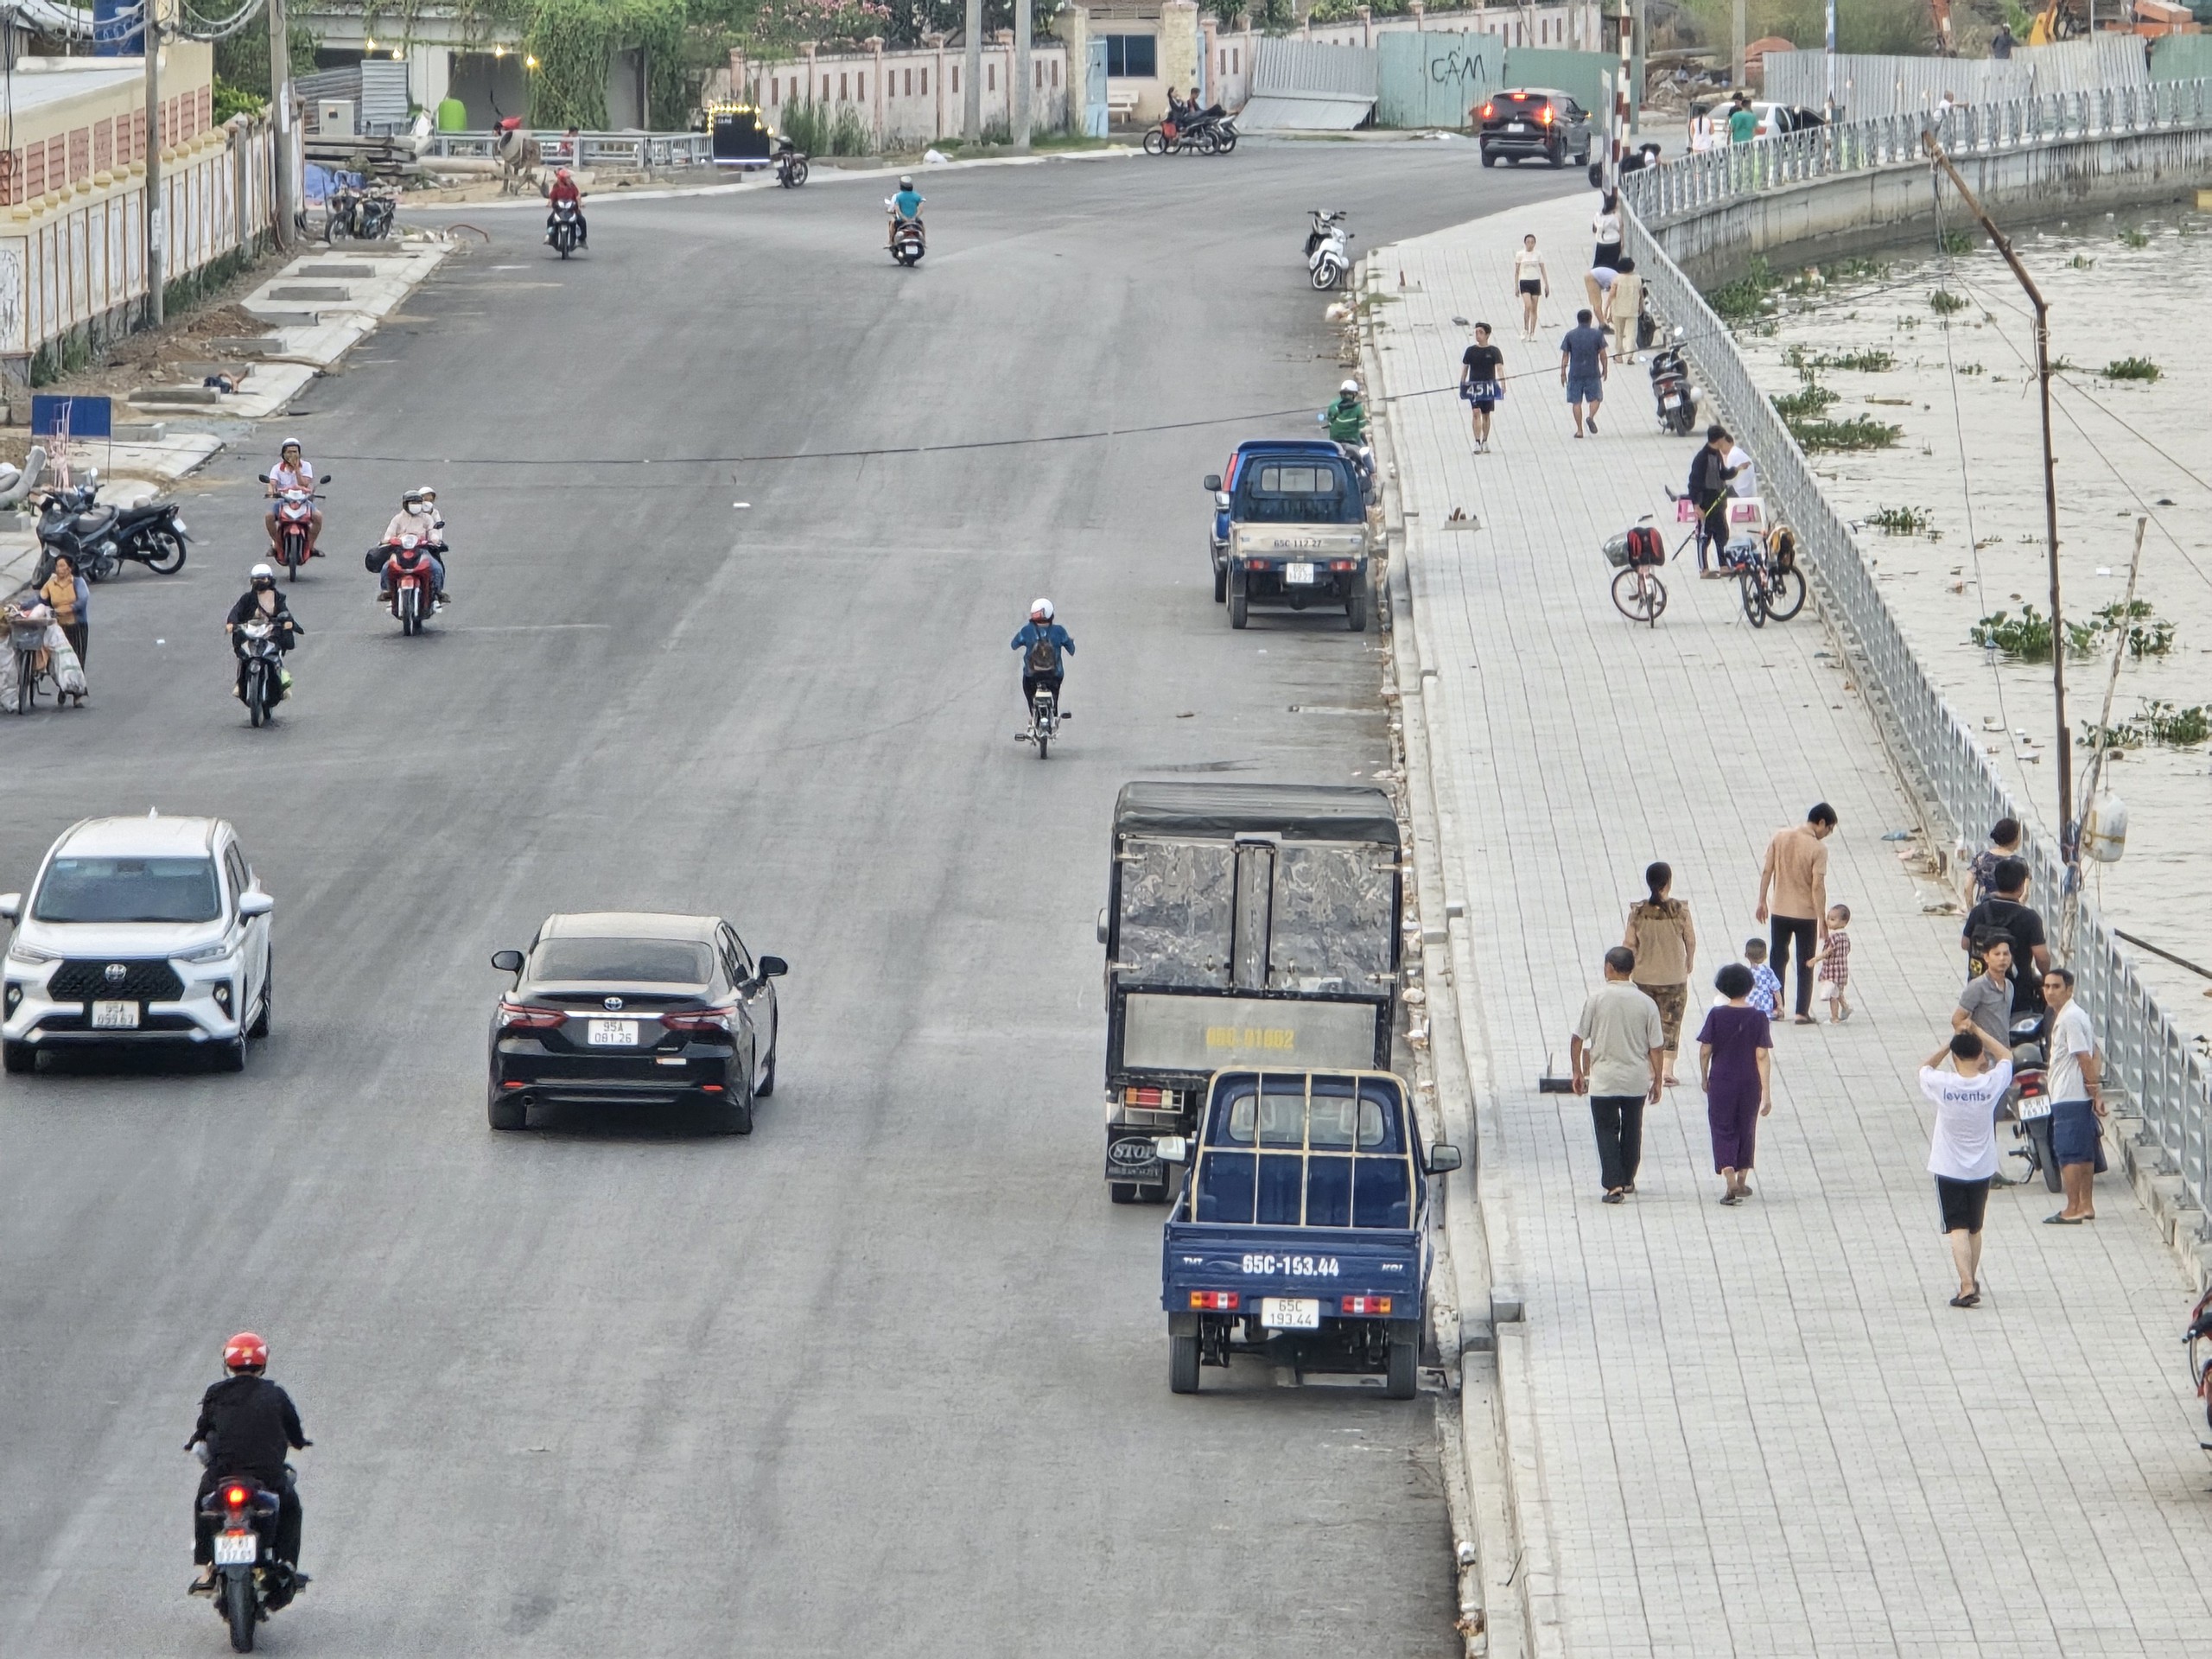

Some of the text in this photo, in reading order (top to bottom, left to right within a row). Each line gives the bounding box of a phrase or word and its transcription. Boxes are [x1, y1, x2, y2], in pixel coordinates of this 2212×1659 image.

[603, 1020, 624, 1033] 95A
[1279, 1300, 1303, 1313] 65C
[1270, 1313, 1313, 1326] 193.44
